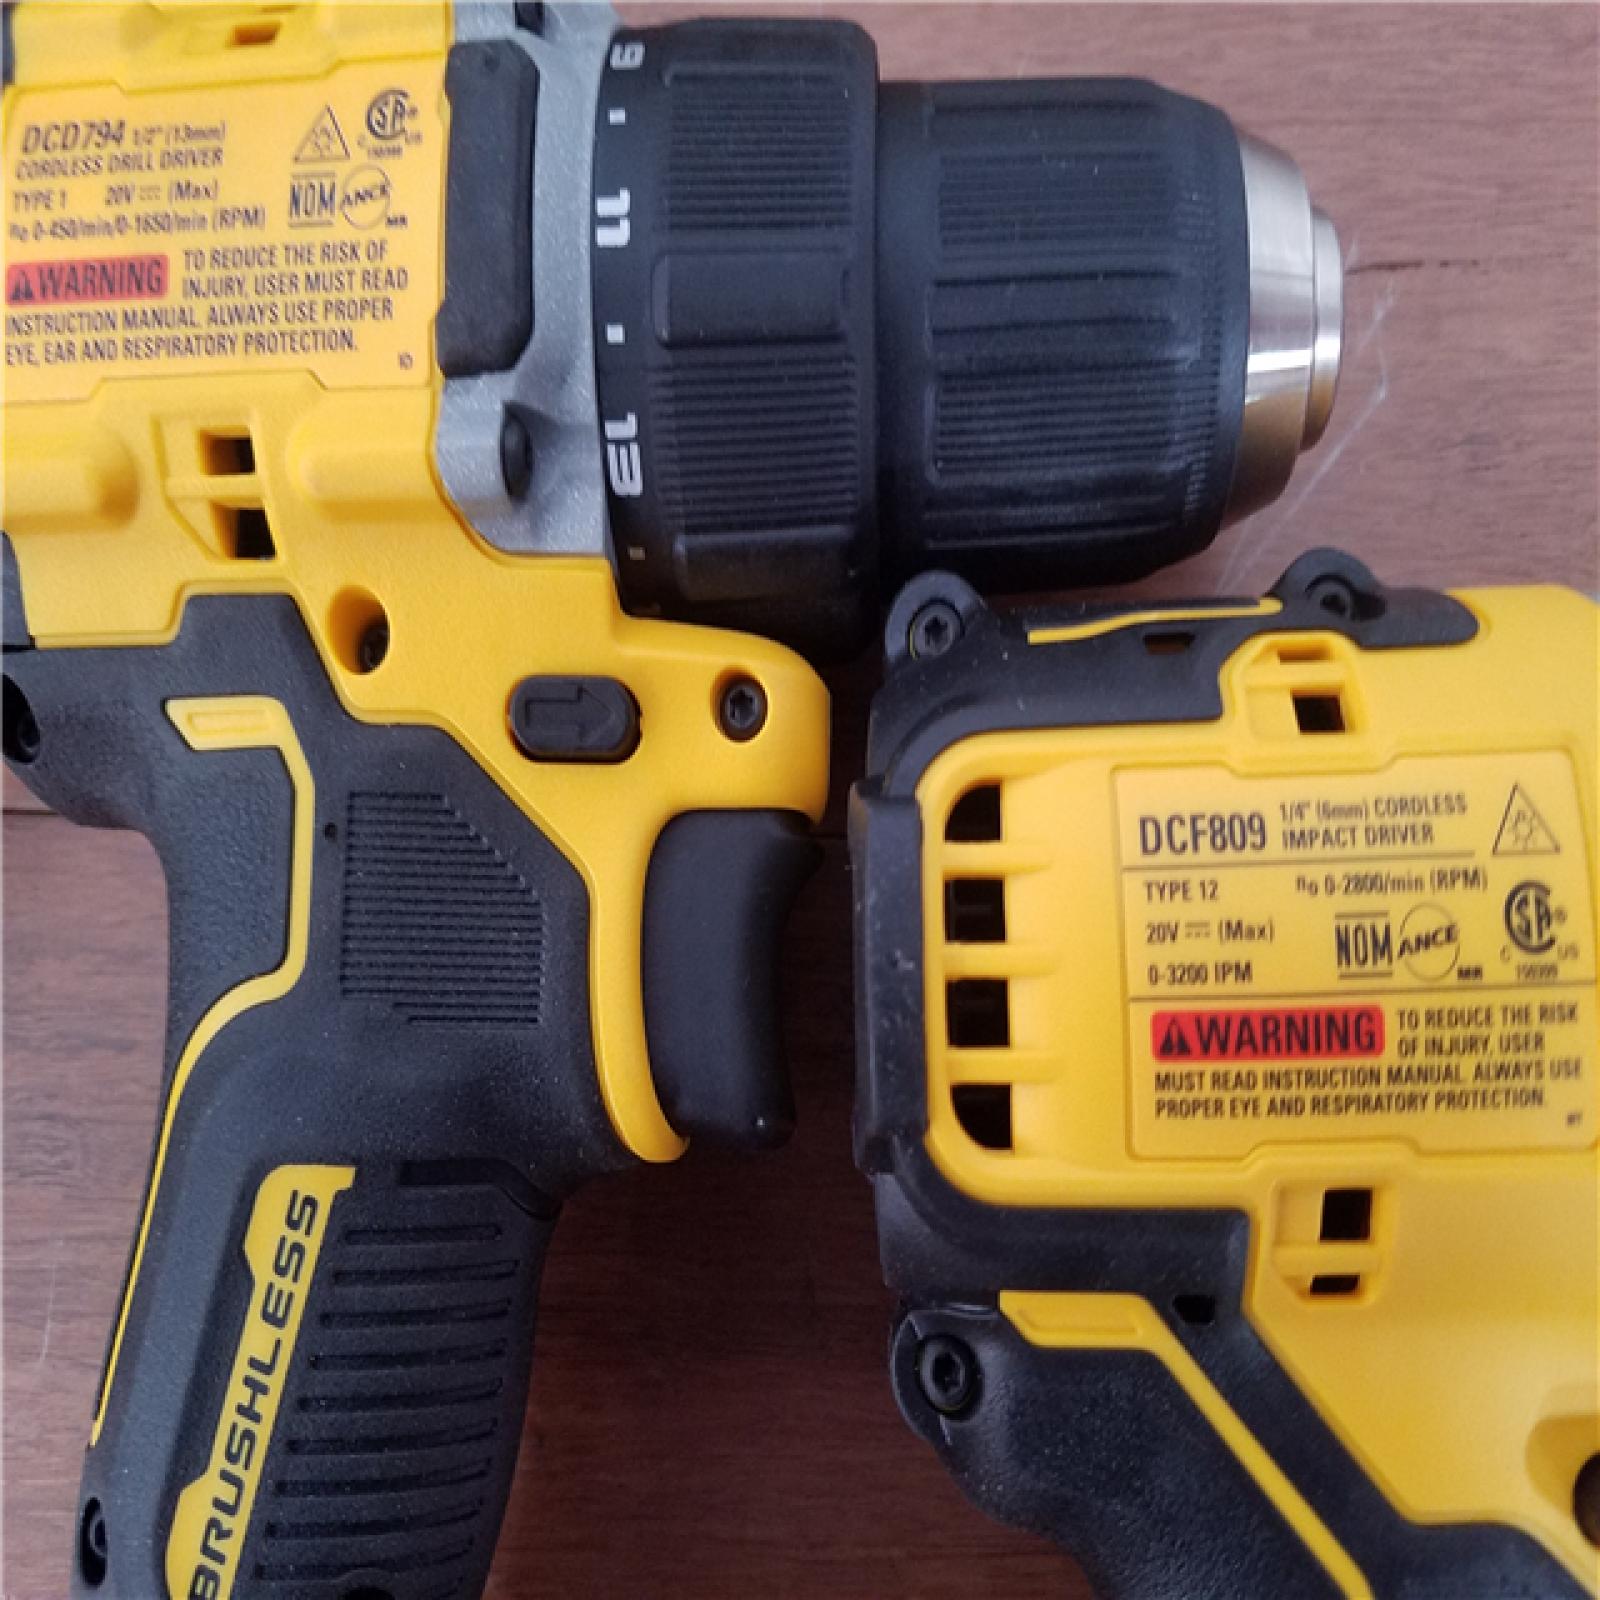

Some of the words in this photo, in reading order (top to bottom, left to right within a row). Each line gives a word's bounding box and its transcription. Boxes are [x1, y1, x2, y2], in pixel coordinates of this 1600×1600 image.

[22, 121, 126, 154] DCD794
[15, 157, 104, 181] CORDLESS
[107, 151, 154, 174] DRILL
[160, 146, 224, 172] DRIVER
[12, 190, 54, 212] TYPE
[105, 184, 135, 206] 20V
[168, 178, 219, 204] (Max)
[290, 180, 337, 217] NOM
[213, 206, 266, 232] (RPM)
[596, 188, 630, 247] 11
[184, 249, 206, 271] TO
[210, 245, 277, 270] REDUCE
[283, 243, 316, 266] THE
[320, 240, 362, 264] RISK
[366, 239, 389, 262] OF
[38, 259, 163, 301] WARNING
[254, 271, 300, 296] USER
[305, 269, 356, 293] MUST
[362, 267, 409, 291] READ
[5, 310, 117, 336] INSTRUCTION
[207, 301, 280, 326] ALWAYS
[285, 300, 318, 322] USE
[323, 297, 394, 321] PROPER
[44, 339, 76, 365] EAR
[82, 337, 118, 361] AND
[123, 331, 237, 360] RESPIRATORY
[604, 412, 643, 496] 13
[1374, 793, 1467, 818] CORDLESS
[1139, 812, 1266, 856] DCF809
[1282, 827, 1357, 849] IMPACT
[1364, 824, 1434, 846] DRIVER
[1145, 880, 1193, 903] TYPE
[1199, 879, 1219, 901] 12
[1323, 868, 1424, 896] 0-2800/min
[1429, 866, 1488, 894] (RPM)
[1146, 922, 1180, 945] 20V
[1218, 915, 1274, 945] (Max)
[1334, 922, 1393, 968] NOM
[1398, 923, 1458, 959] ANCE
[1148, 962, 1208, 986] 0-3200
[1214, 960, 1253, 985] IPM
[1397, 1009, 1420, 1030] TO
[1424, 1007, 1494, 1030] REDUCE
[1501, 1003, 1532, 1026] THE
[1538, 1002, 1578, 1024] RISK
[1195, 1012, 1377, 1055] WARNING
[1398, 1036, 1418, 1057] OF
[1499, 1032, 1545, 1053] USER
[1155, 1070, 1205, 1092] MUST
[1210, 1069, 1258, 1092] READ
[1262, 1065, 1382, 1090] INSTRUCTION
[1473, 1059, 1546, 1082] ALWAYS
[1549, 1057, 1582, 1080] USE
[1155, 1098, 1225, 1119] PROPER
[1229, 1097, 1261, 1118] EYE
[1267, 1095, 1306, 1117] AND
[1310, 1090, 1429, 1116] RESPIRATORY
[187, 1190, 318, 1600] BRUSHLESS
